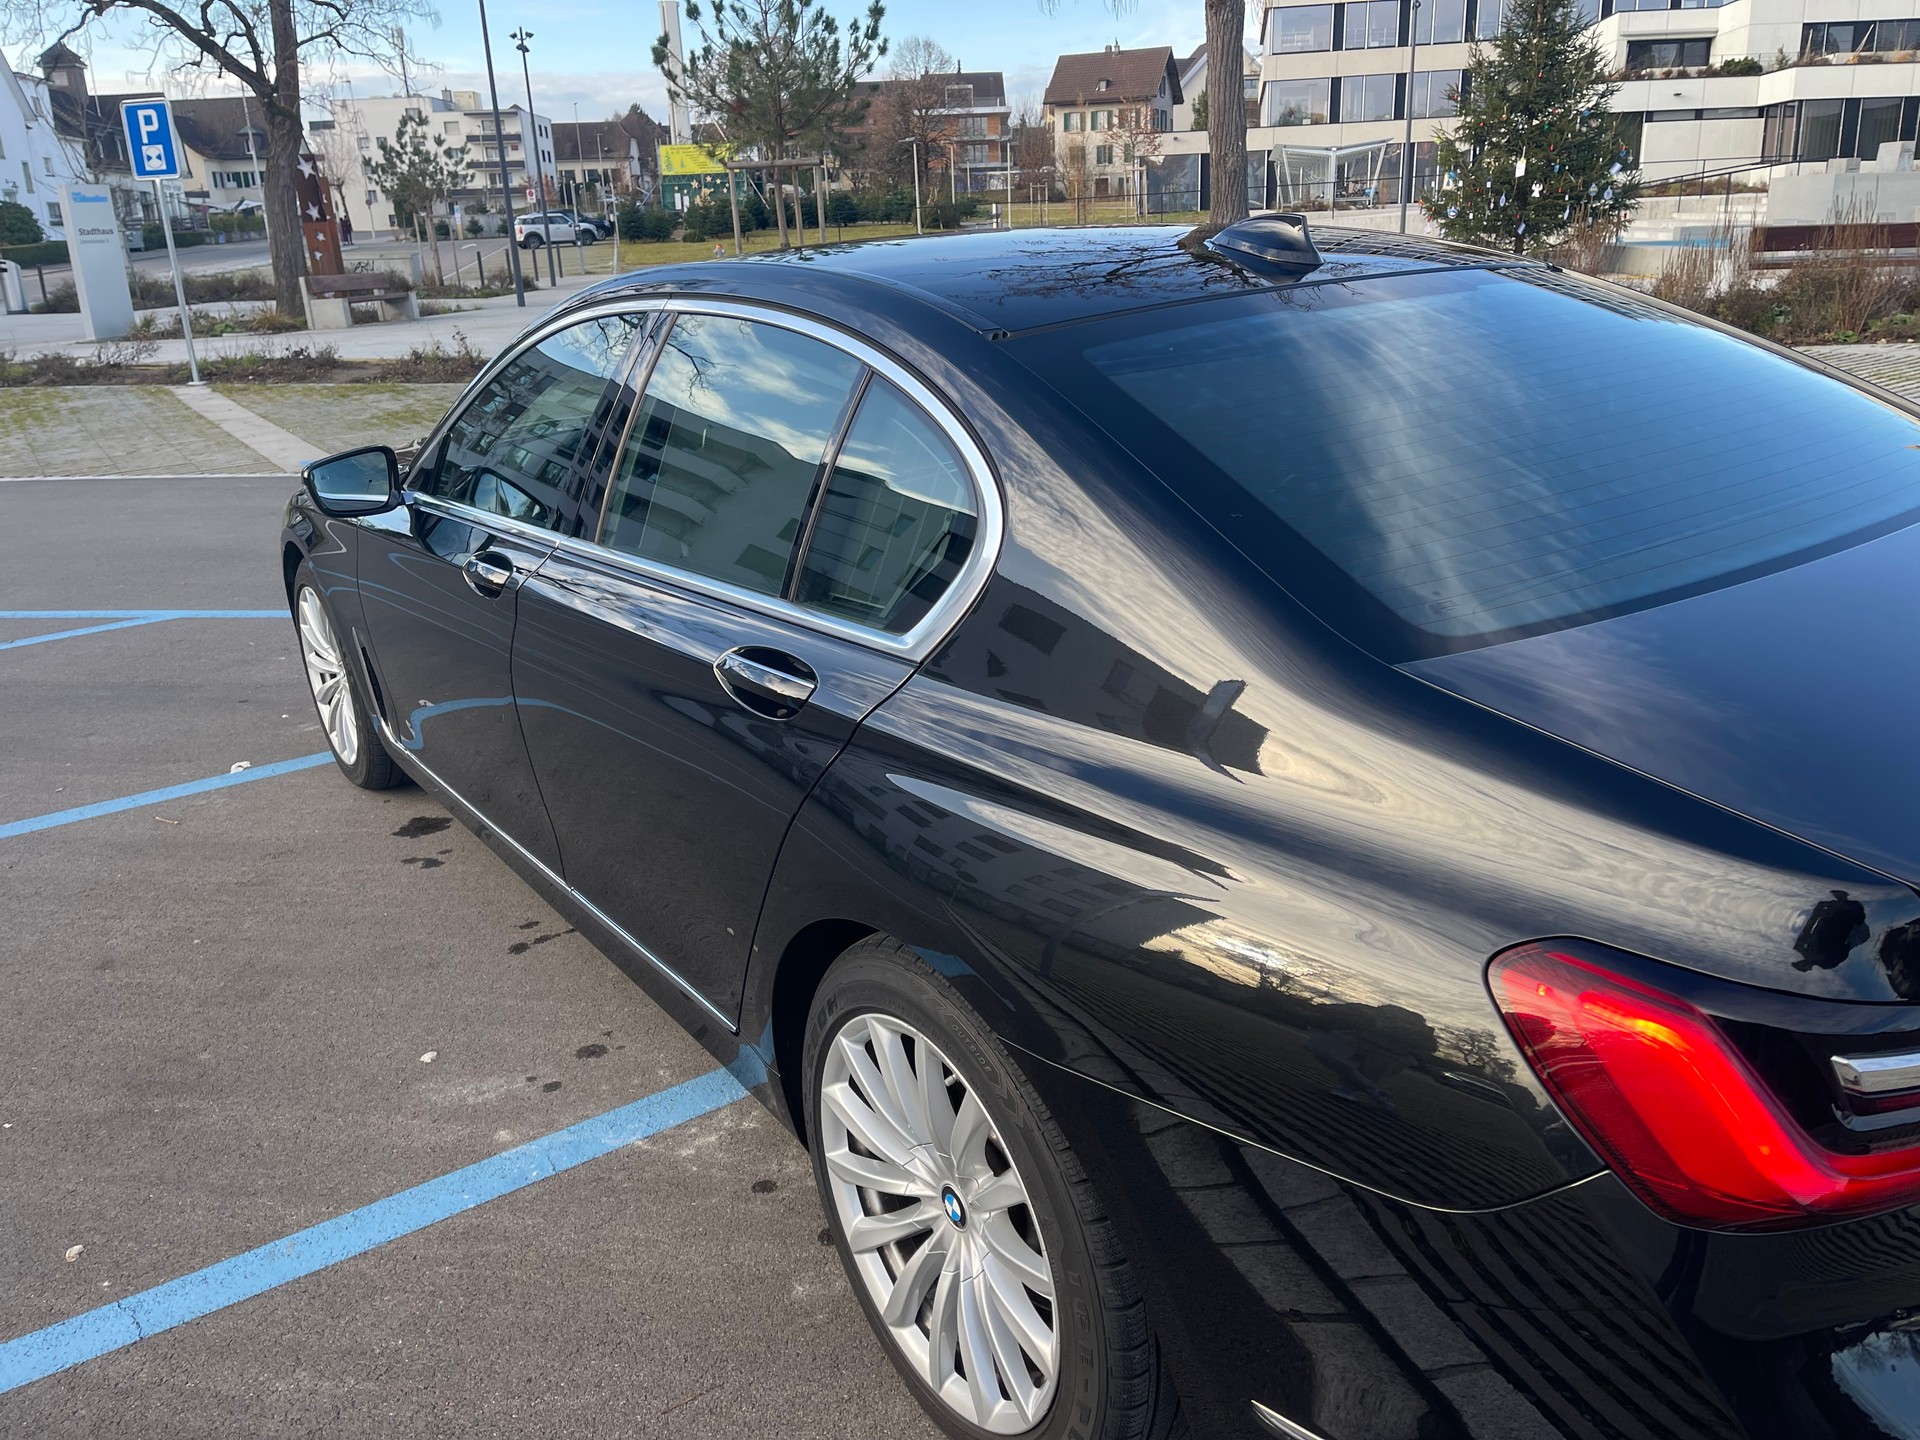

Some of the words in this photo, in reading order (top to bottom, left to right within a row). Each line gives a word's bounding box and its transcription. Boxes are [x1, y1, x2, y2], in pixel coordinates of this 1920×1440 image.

[137, 108, 159, 144] P
[78, 227, 114, 236] Stadthaus
[951, 1024, 993, 1073] OUTSIDE
